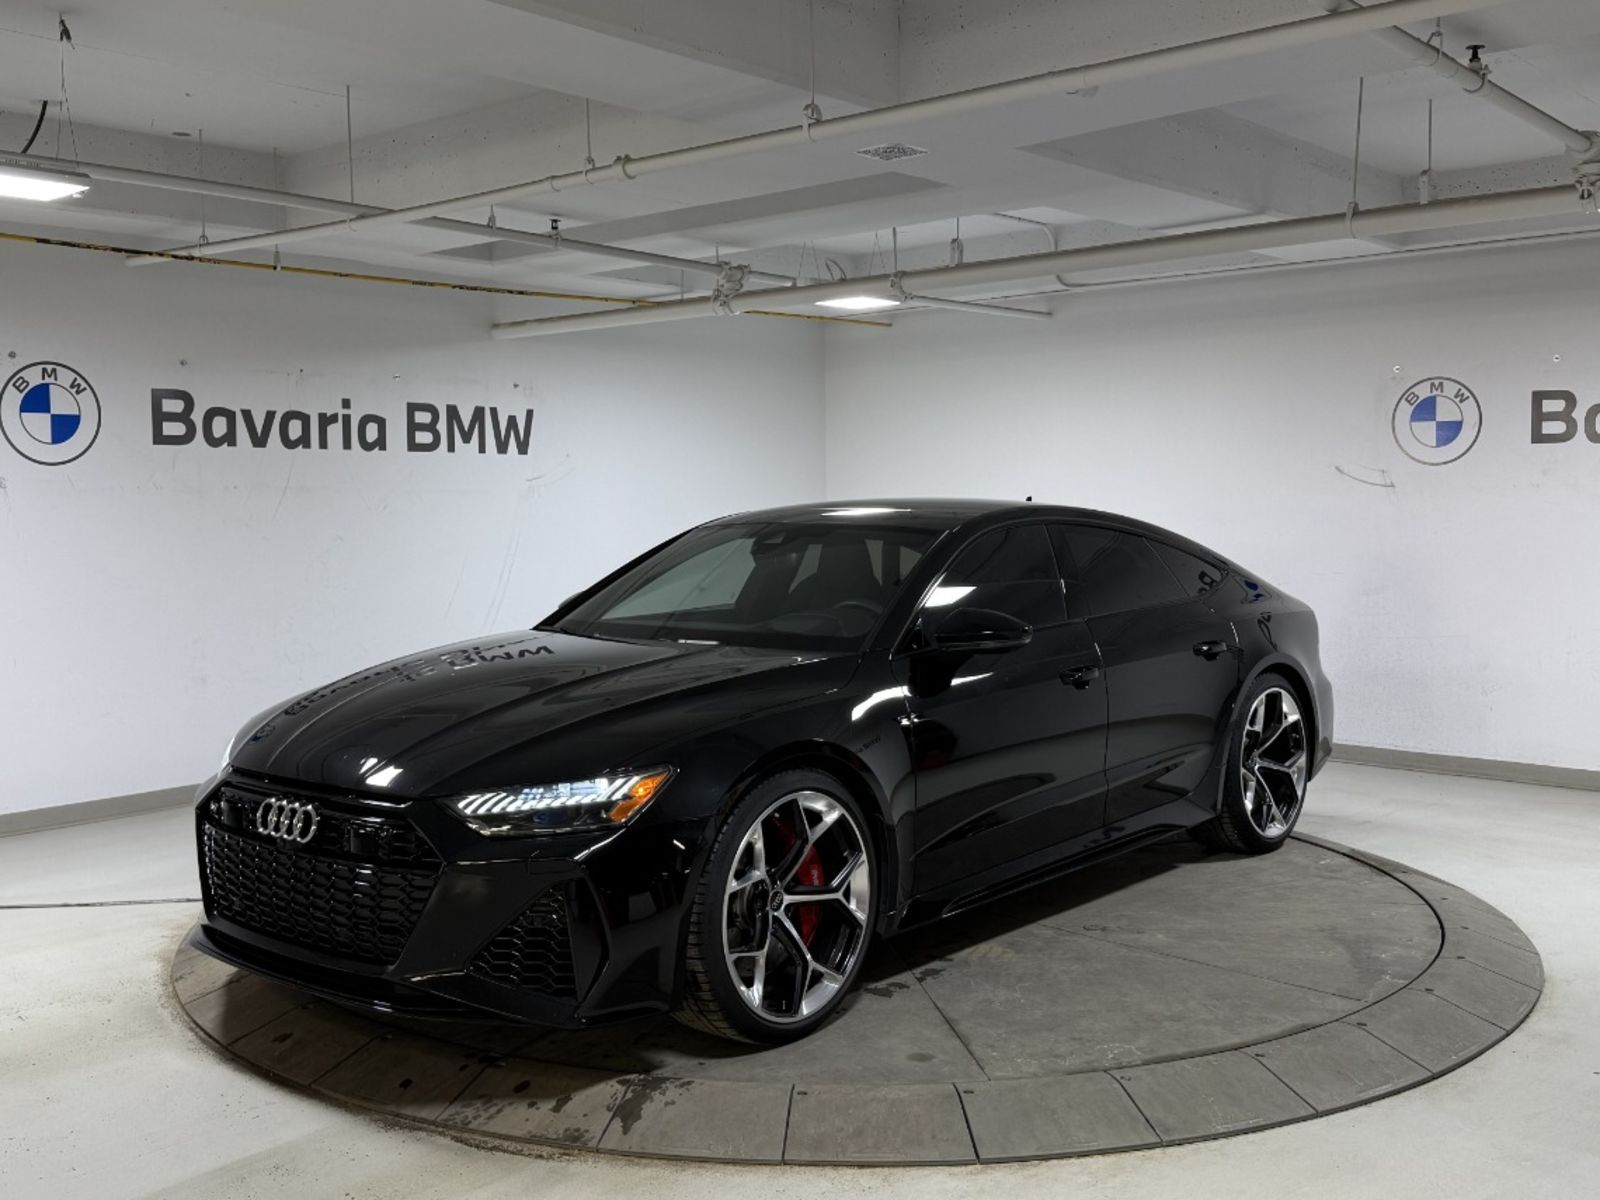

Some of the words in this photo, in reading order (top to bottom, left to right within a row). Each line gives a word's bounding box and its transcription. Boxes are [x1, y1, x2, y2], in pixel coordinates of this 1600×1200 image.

[12, 367, 87, 396] BMW
[1405, 381, 1470, 407] BMW
[151, 388, 387, 452] Bavaria
[406, 402, 534, 455] BMW
